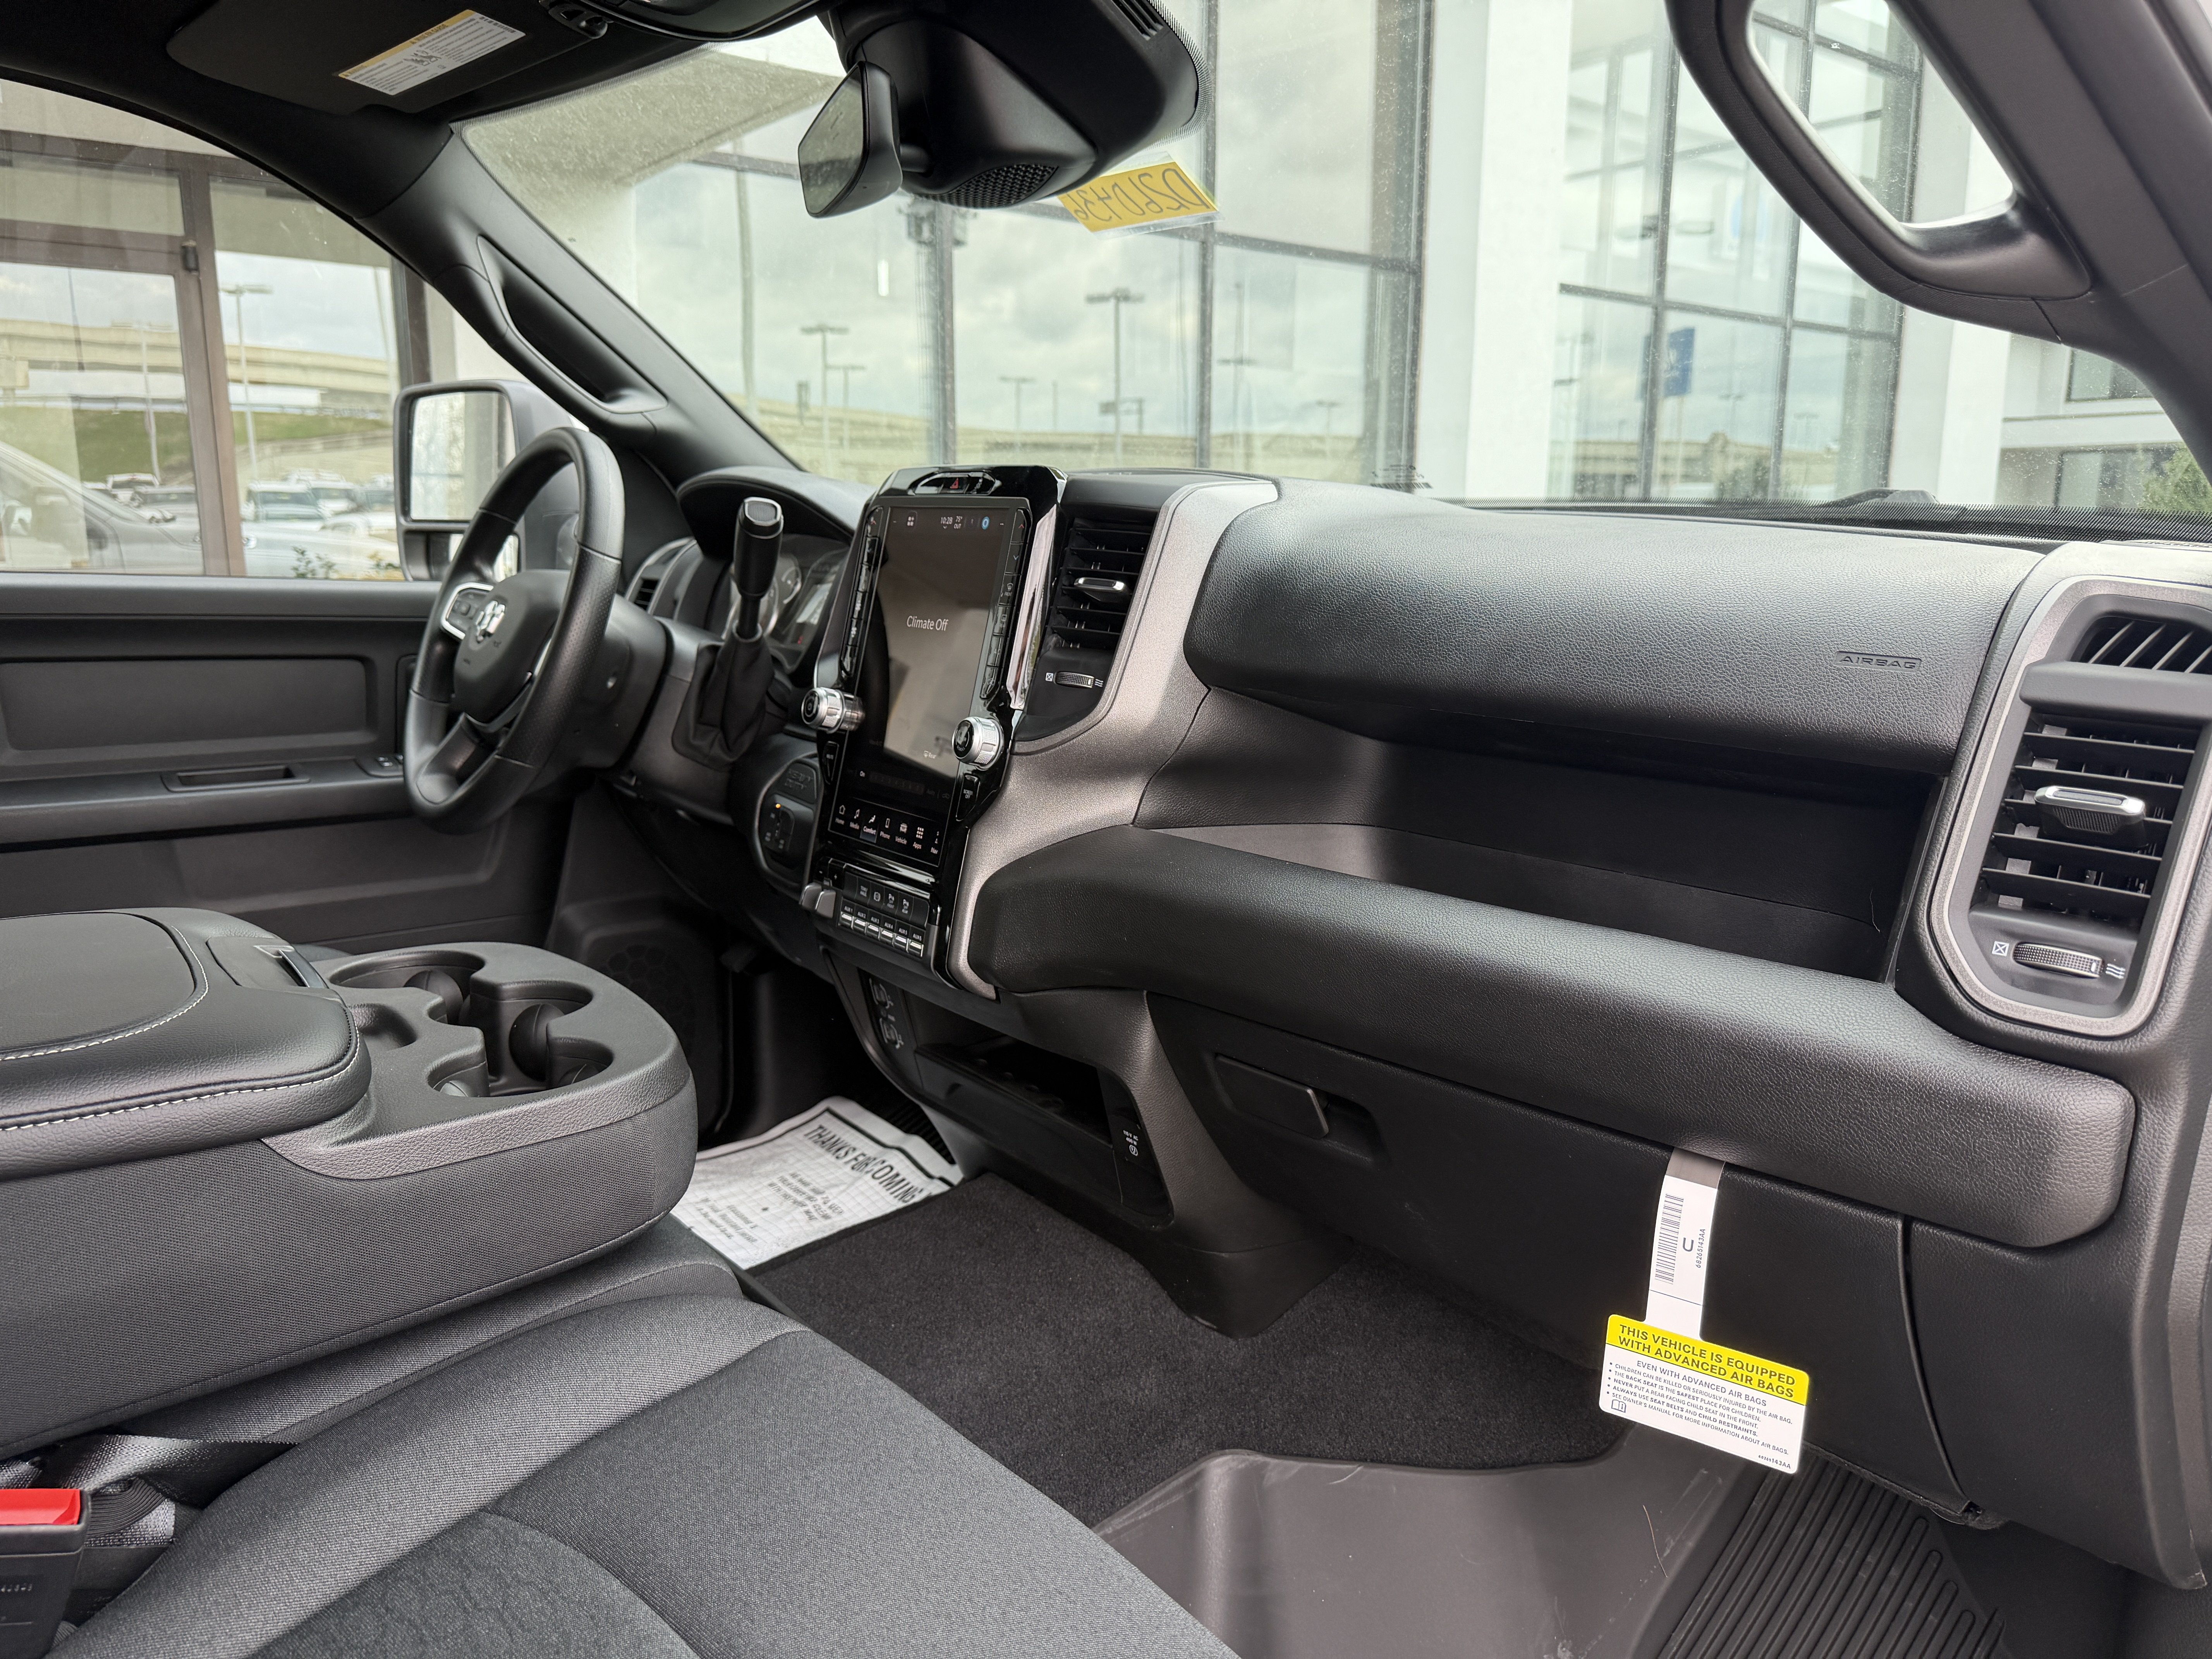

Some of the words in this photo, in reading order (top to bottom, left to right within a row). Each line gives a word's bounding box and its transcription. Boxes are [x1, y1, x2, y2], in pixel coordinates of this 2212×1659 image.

[940, 516, 953, 525] 10:28
[907, 615, 934, 630] Climate
[935, 618, 949, 631] Off
[1839, 656, 1916, 669] AIRBAG
[863, 826, 876, 835] Comfort
[879, 831, 890, 840] Phone
[895, 835, 907, 845] Vehicle
[913, 842, 922, 850] Apps
[804, 1124, 857, 1159] THANKS
[864, 1159, 925, 1204] COMING
[1695, 1229, 1706, 1268] 68265143AA
[1618, 1335, 1650, 1353] WITH
[1654, 1347, 1727, 1376] ADVANCED
[1730, 1371, 1753, 1386] AIR
[1757, 1378, 1793, 1398] BAGS
[1620, 1324, 1648, 1340] THIS
[1652, 1333, 1707, 1359] VEHICLE
[1710, 1352, 1723, 1363] IS
[1726, 1357, 1795, 1385] EQUIPPED
[1613, 1378, 1633, 1388] NEVER
[1686, 1401, 1704, 1410] CHILD
[1704, 1407, 1718, 1415] SEAT
[1726, 1414, 1737, 1422] THE
[1738, 1418, 1758, 1429] FRONT.
[1615, 1363, 1642, 1376] CHILDREN
[1663, 1378, 1682, 1388] KILLED
[1692, 1388, 1722, 1401] SERIOUSLY
[1723, 1397, 1746, 1409] INJURED
[1756, 1408, 1767, 1416] THE
[1779, 1415, 1792, 1424] BAG.
[1625, 1374, 1642, 1383] BACK
[1642, 1379, 1657, 1388] SEAT
[1676, 1390, 1699, 1401] SAFEST
[1700, 1398, 1717, 1408] PLACE
[1718, 1403, 1730, 1412] FOR
[1731, 1408, 1761, 1422] CHILDREN.
[1637, 1360, 1657, 1372] EVEN
[1659, 1367, 1680, 1379] WITH
[1681, 1374, 1726, 1393] ADVANCED
[1728, 1389, 1742, 1399] AIR
[1744, 1393, 1766, 1407] BAGS
[1613, 1385, 1637, 1397] ALWAYS
[1650, 1397, 1665, 1406] SEAT
[1666, 1402, 1684, 1412] BELTS
[1698, 1413, 1717, 1422] CHILD
[1718, 1419, 1758, 1437] RESTRAINTS.
[1623, 1396, 1647, 1407] OWNER'S
[1648, 1404, 1671, 1415] MANUAL
[1684, 1415, 1700, 1425] MORE
[1701, 1421, 1740, 1438] INFORMATION
[1740, 1434, 1760, 1445] ABOUT
[1772, 1445, 1788, 1455] BAGS.
